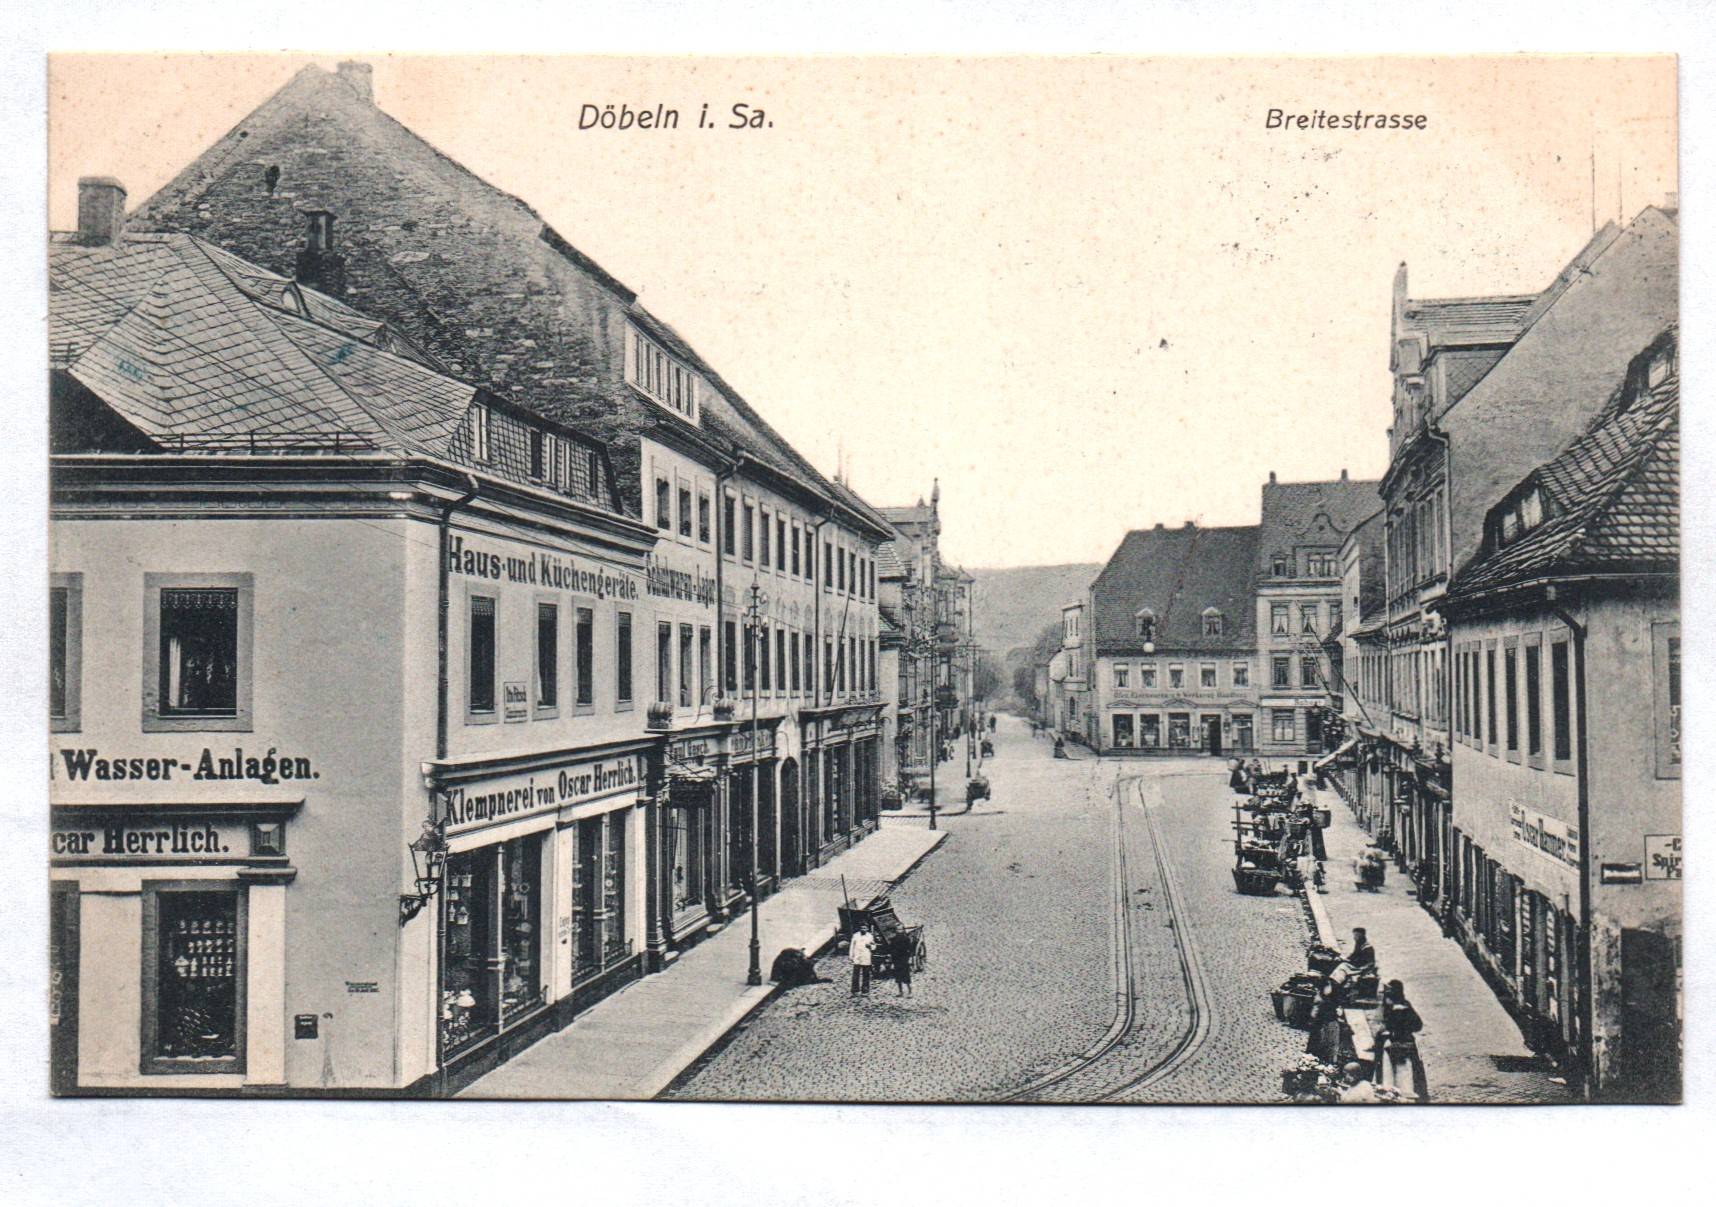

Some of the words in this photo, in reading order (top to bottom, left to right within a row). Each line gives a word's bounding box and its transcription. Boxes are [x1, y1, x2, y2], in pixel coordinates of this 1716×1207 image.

[540, 553, 639, 600] Küchengeräte.
[60, 747, 321, 785] Wasser-Anlagen.
[448, 777, 535, 826] Klempnerei
[536, 787, 556, 806] von
[558, 770, 592, 800] Oscar
[593, 758, 637, 792] Herrlich.
[52, 830, 96, 855] car
[102, 820, 229, 855] Herrlich.
